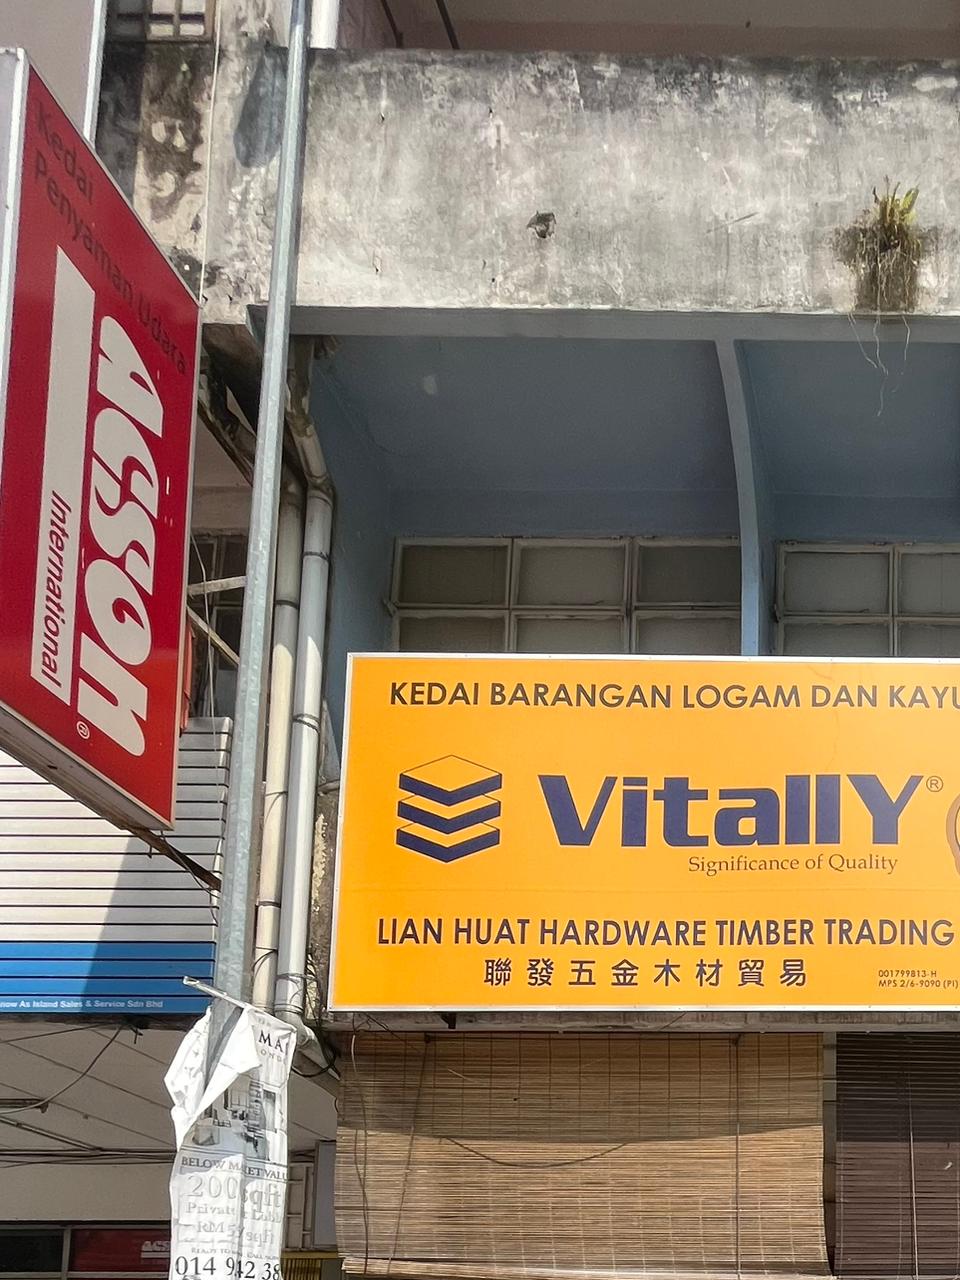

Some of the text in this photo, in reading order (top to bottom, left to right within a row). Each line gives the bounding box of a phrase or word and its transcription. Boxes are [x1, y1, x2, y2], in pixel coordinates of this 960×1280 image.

[36, 101, 95, 205] Kedai
[35, 149, 187, 375] Penyaman Udara
[40, 490, 72, 689] International
[390, 682, 479, 706] KEDAI
[490, 683, 672, 708] BARANGAN
[683, 685, 801, 709] LOGAM
[811, 685, 878, 708] DAN
[688, 853, 899, 877] Significance of Quality
[378, 918, 956, 946] LIAN HUAT HARDWARE TIMBER TRADING
[878, 979, 898, 988] MPS
[181, 1156, 226, 1170] BELOW
[174, 1255, 217, 1276] 014
